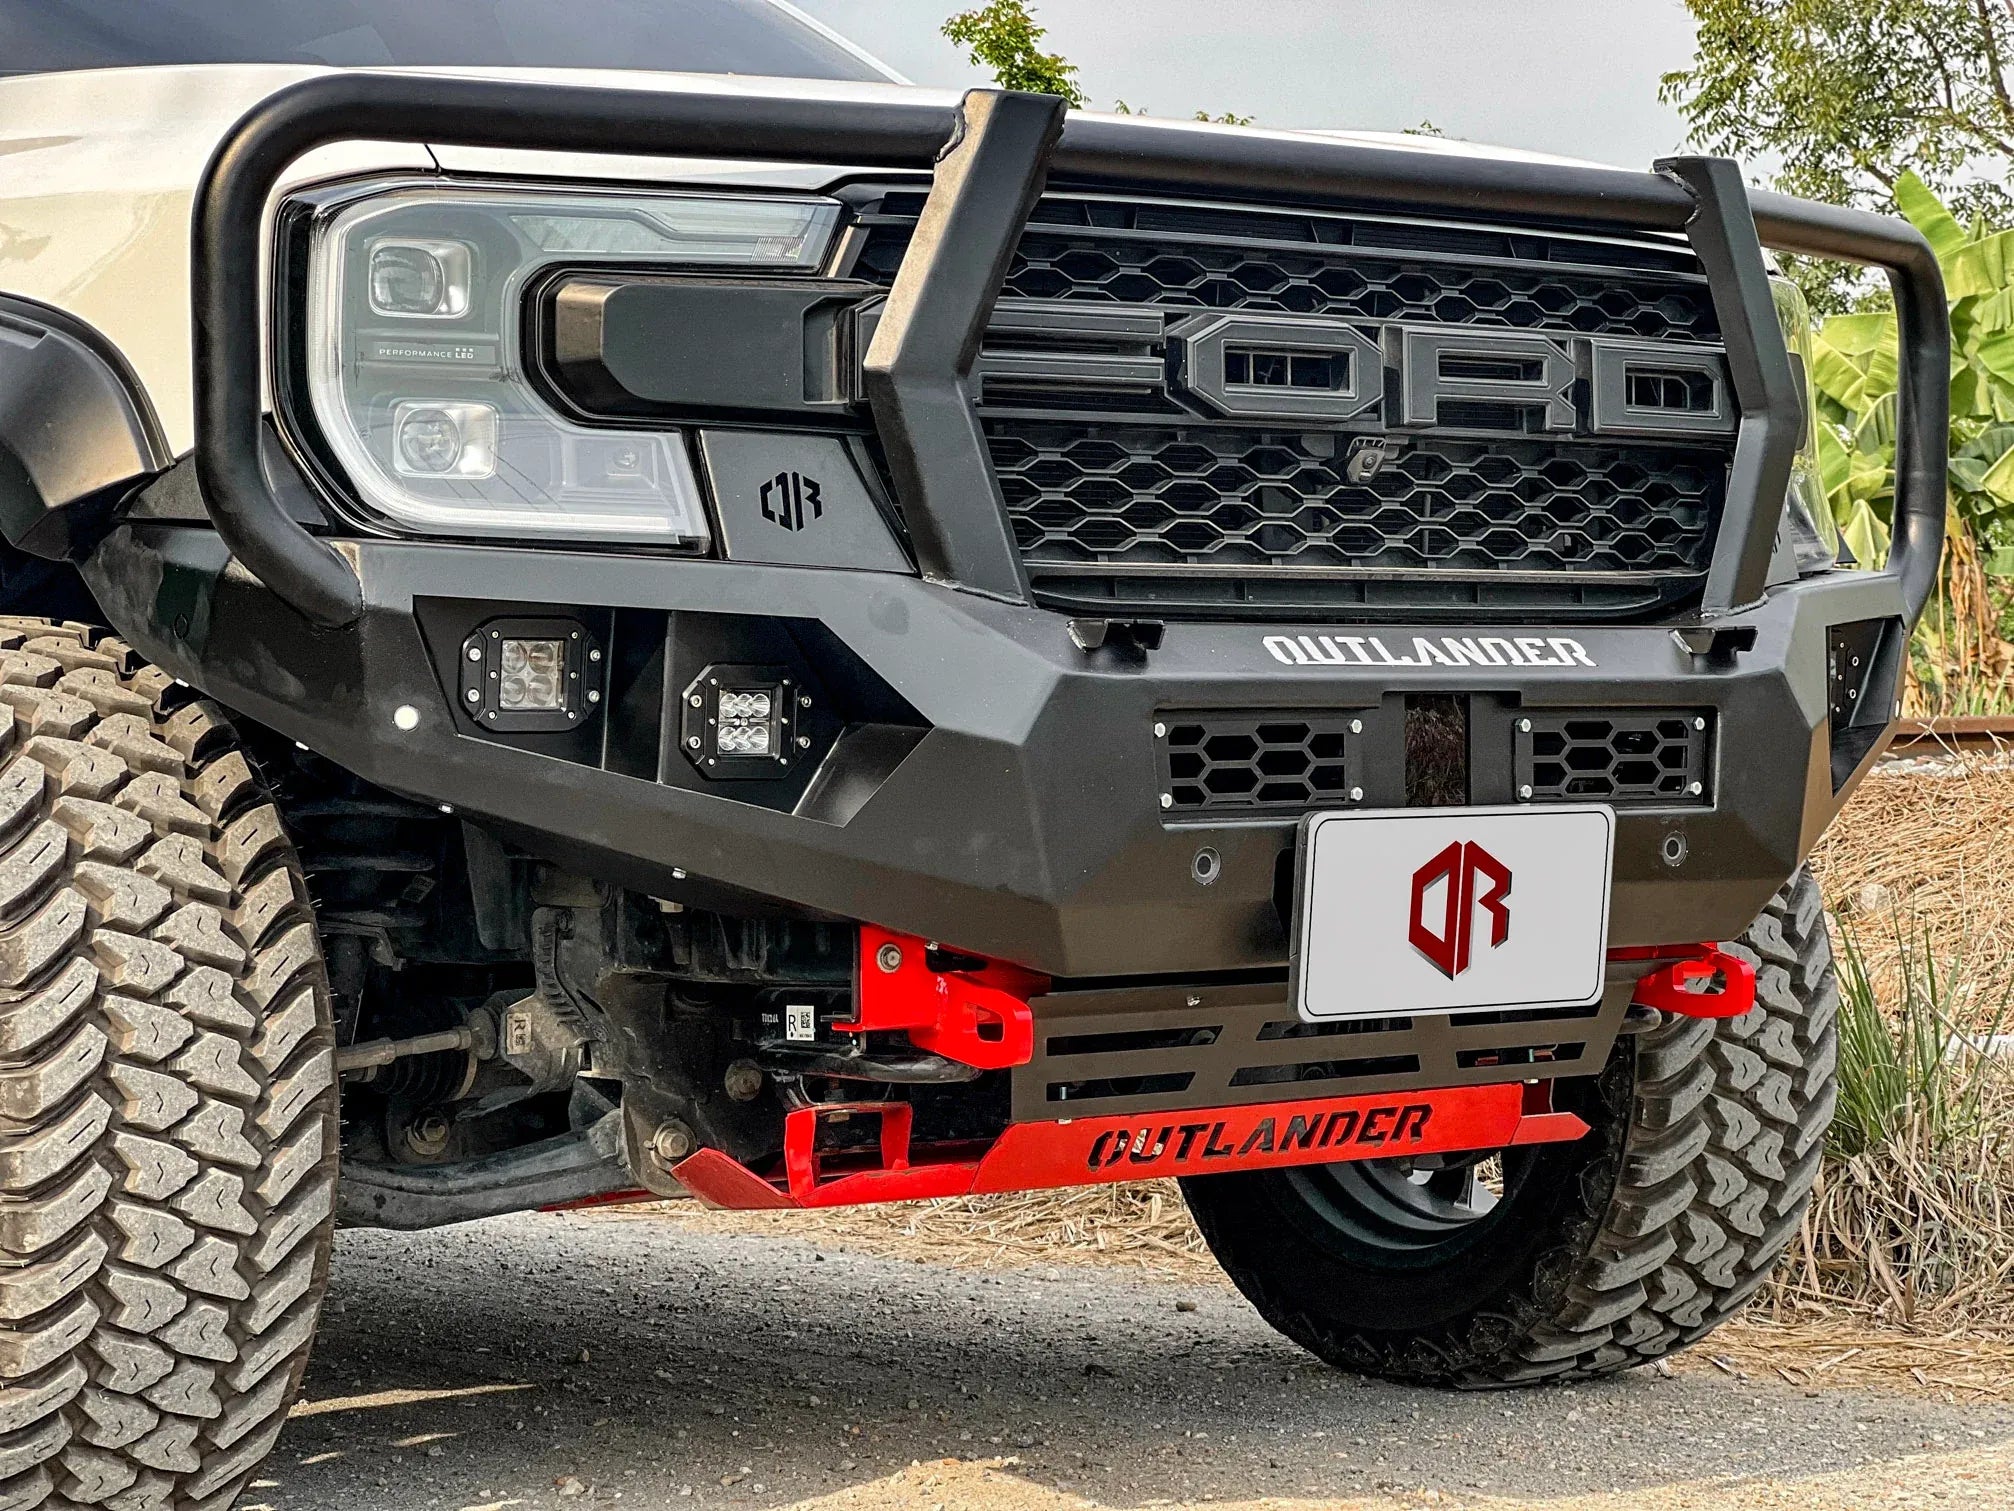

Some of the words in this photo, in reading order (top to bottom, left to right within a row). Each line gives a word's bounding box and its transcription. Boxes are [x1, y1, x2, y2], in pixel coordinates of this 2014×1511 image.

[379, 348, 453, 359] PERFORMANCE
[455, 351, 474, 359] LED
[1262, 635, 1599, 667] OUTLANDER
[788, 1014, 797, 1032] R
[1086, 1103, 1434, 1172] OUTLANDER
